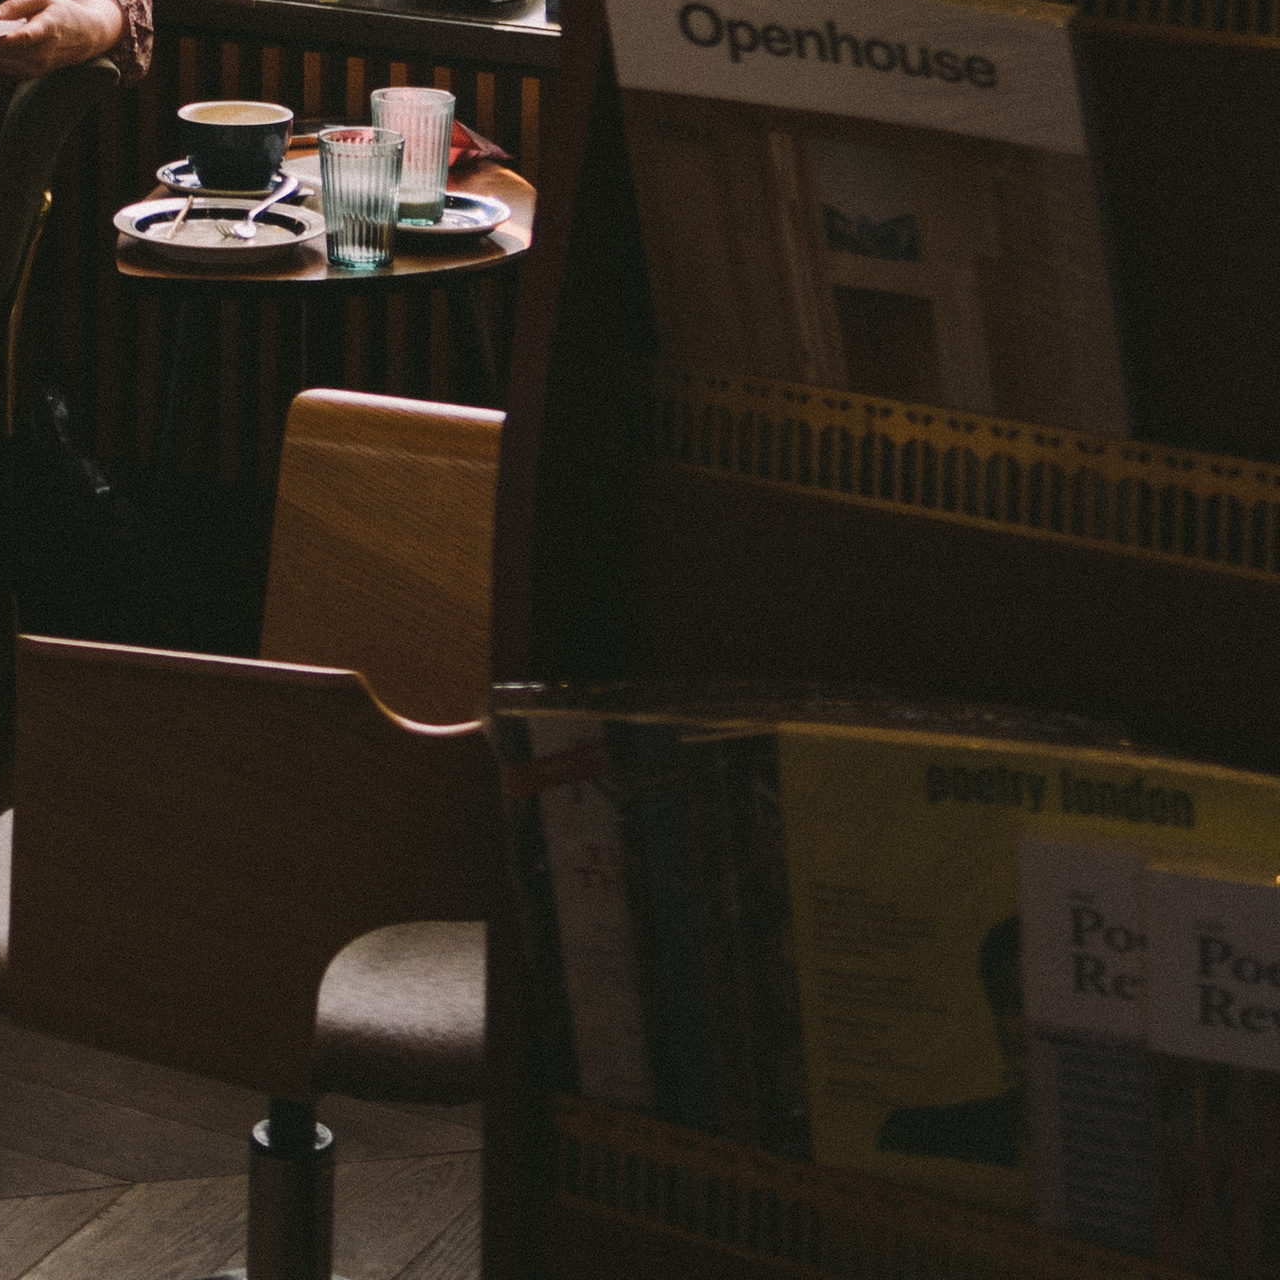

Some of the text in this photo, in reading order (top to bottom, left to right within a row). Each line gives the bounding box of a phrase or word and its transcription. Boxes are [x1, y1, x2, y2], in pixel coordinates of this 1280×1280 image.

[678, 2, 997, 88] Openhouse
[924, 762, 1197, 829] poetry london
